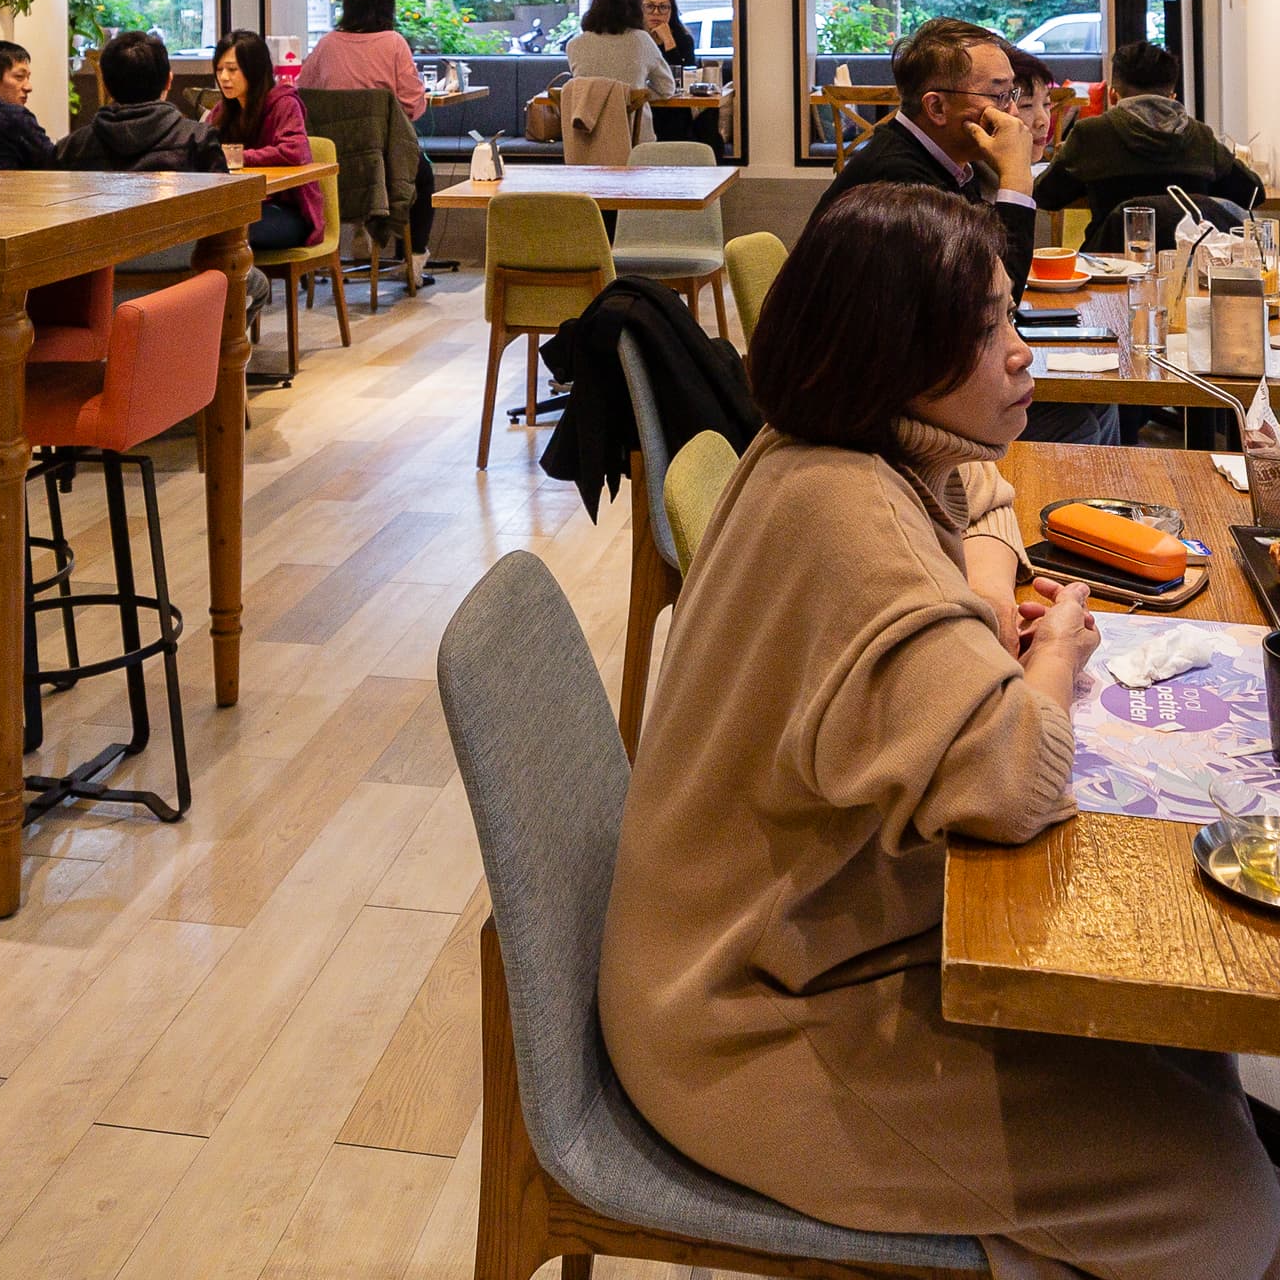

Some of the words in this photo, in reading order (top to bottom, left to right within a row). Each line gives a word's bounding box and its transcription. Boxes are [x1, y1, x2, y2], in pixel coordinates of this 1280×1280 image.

[1129, 689, 1154, 722] arden
[1151, 685, 1182, 721] petite
[1179, 687, 1208, 713] royal
